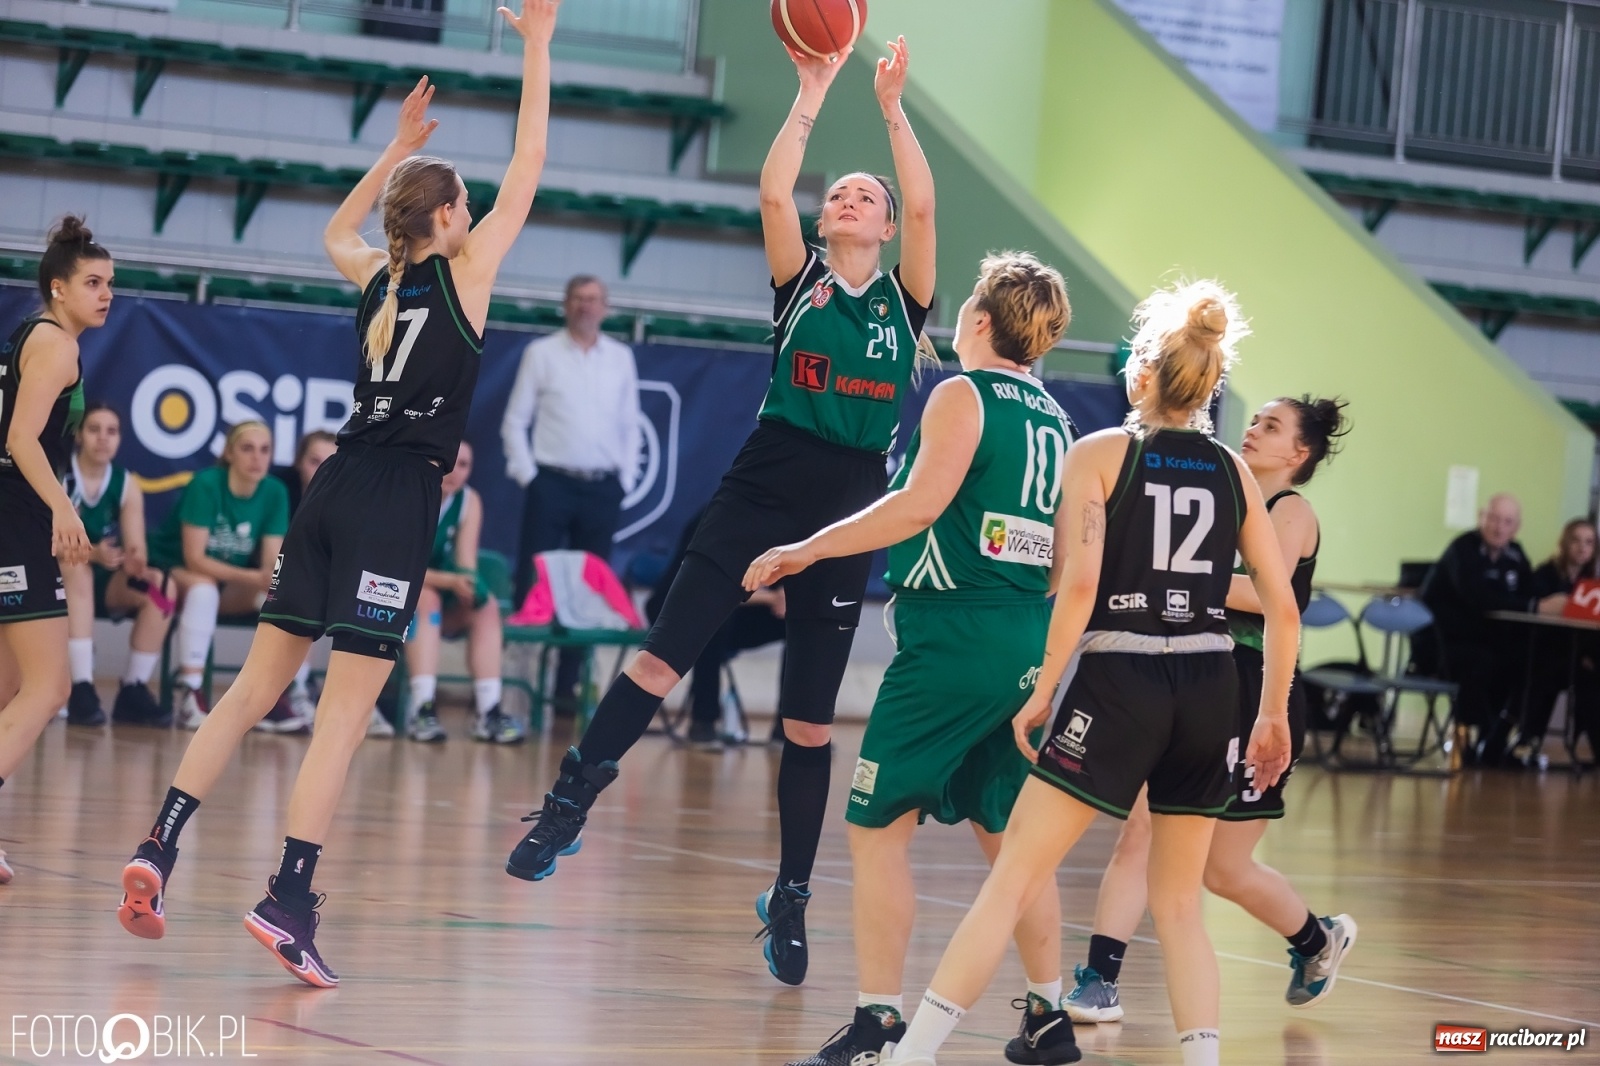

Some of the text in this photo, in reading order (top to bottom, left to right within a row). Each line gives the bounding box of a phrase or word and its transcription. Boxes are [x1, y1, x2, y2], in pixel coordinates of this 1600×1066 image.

[866, 322, 898, 361] 24
[835, 375, 895, 399] KAMAN
[1021, 419, 1064, 514] 10
[1165, 457, 1217, 472] Kraków
[1144, 481, 1216, 575] 12
[1108, 592, 1149, 610] CSiR
[357, 604, 396, 622] LUCY
[1161, 609, 1195, 619] ASPERGO
[1055, 734, 1087, 754] ASPERGO
